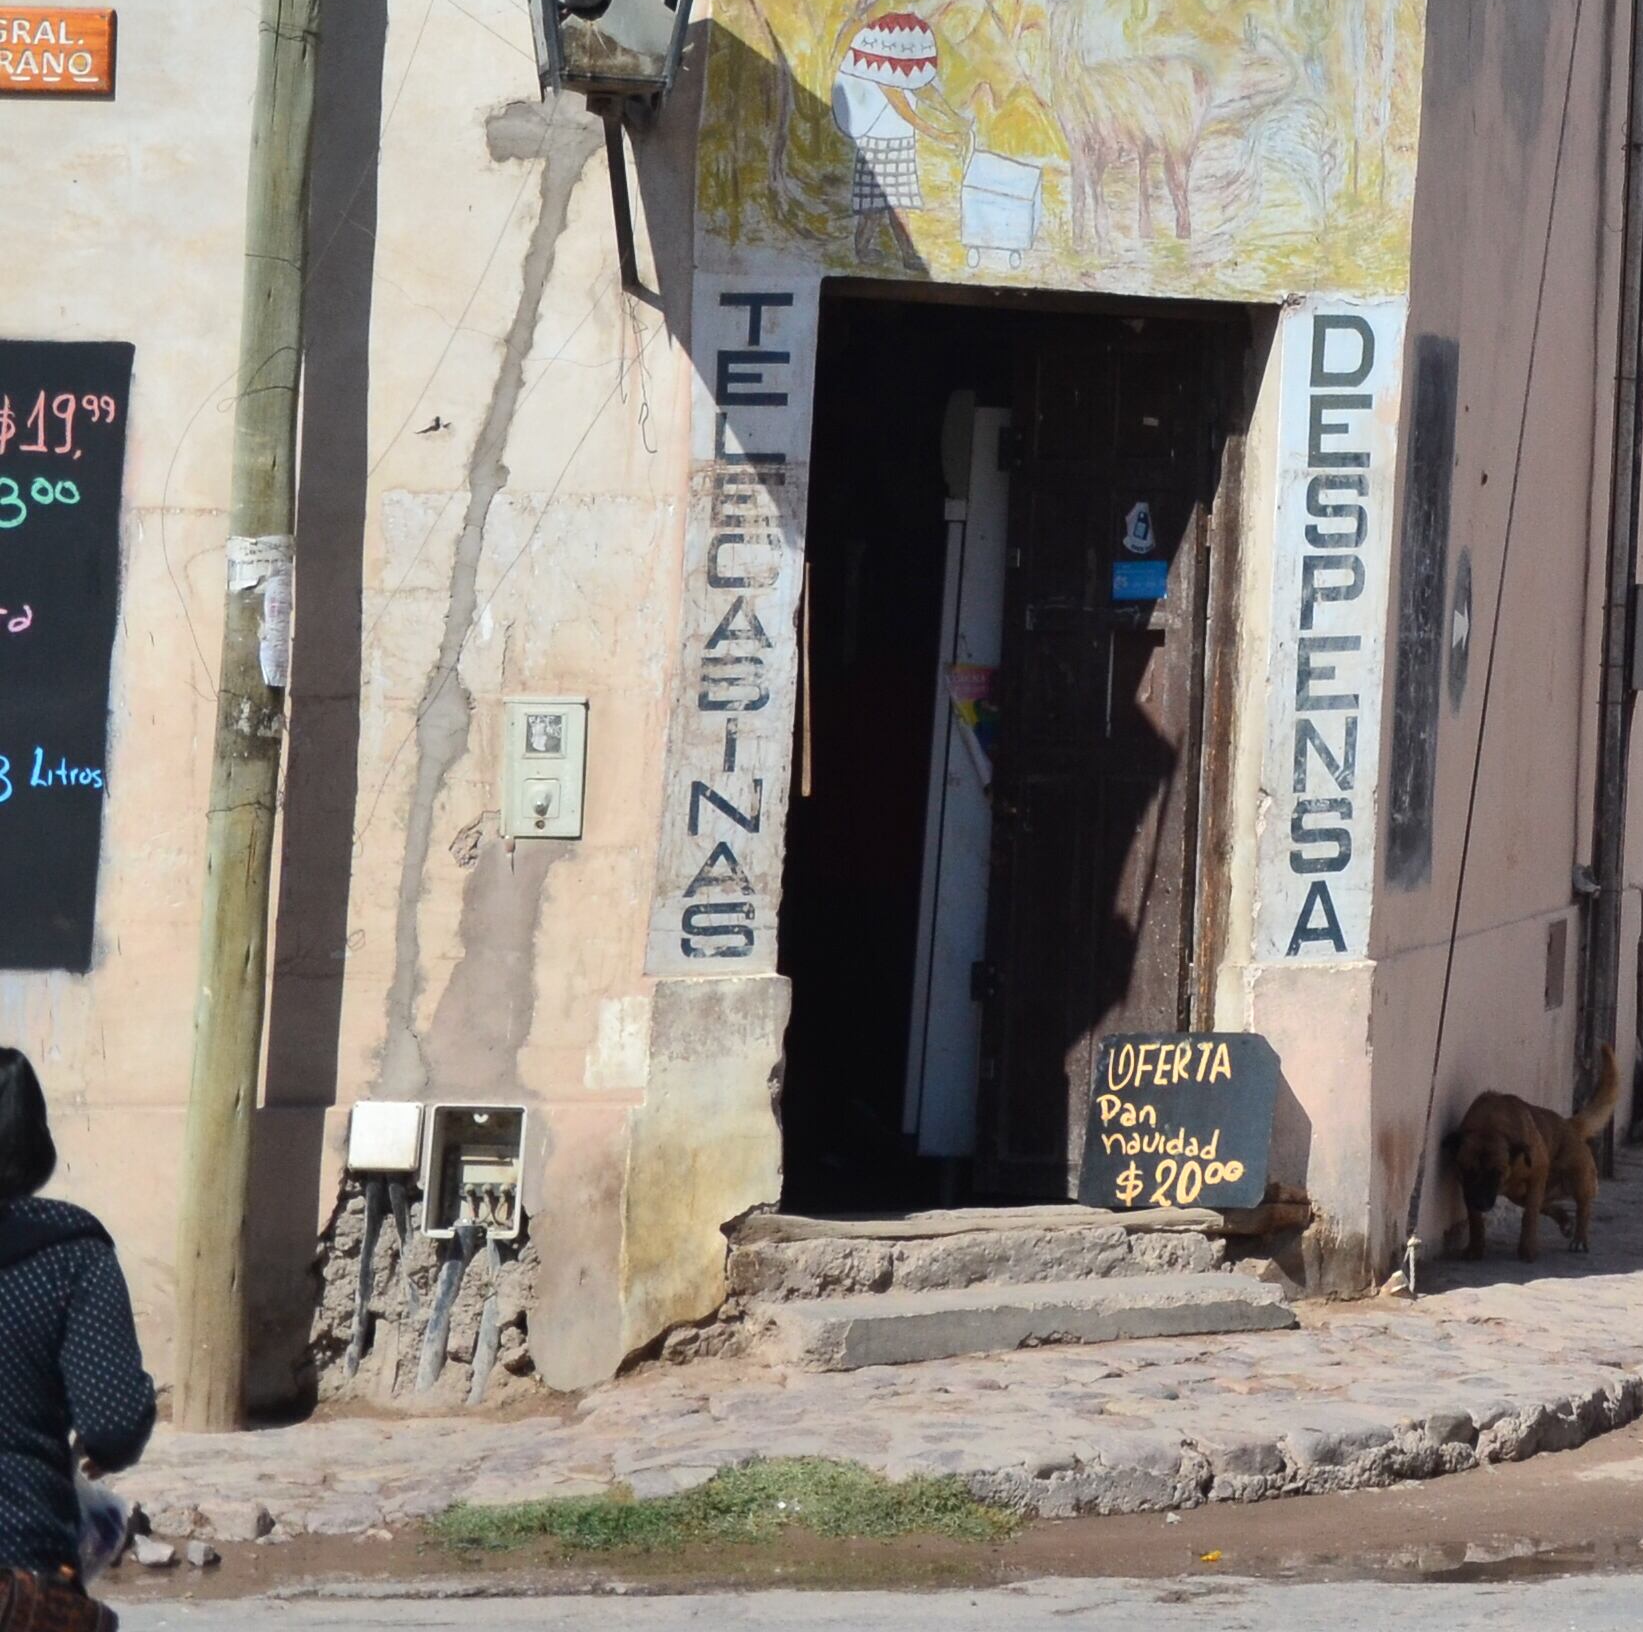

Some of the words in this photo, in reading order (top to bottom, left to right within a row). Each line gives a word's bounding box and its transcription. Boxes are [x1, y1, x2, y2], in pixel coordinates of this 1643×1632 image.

[681, 292, 794, 959] TELECABINAS
[1285, 314, 1376, 957] DESPENSA
[30, 746, 104, 788] Litros
[1108, 1042, 1232, 1091] OFERTA
[1096, 1094, 1157, 1128] Pan
[1101, 1127, 1220, 1160] navidad
